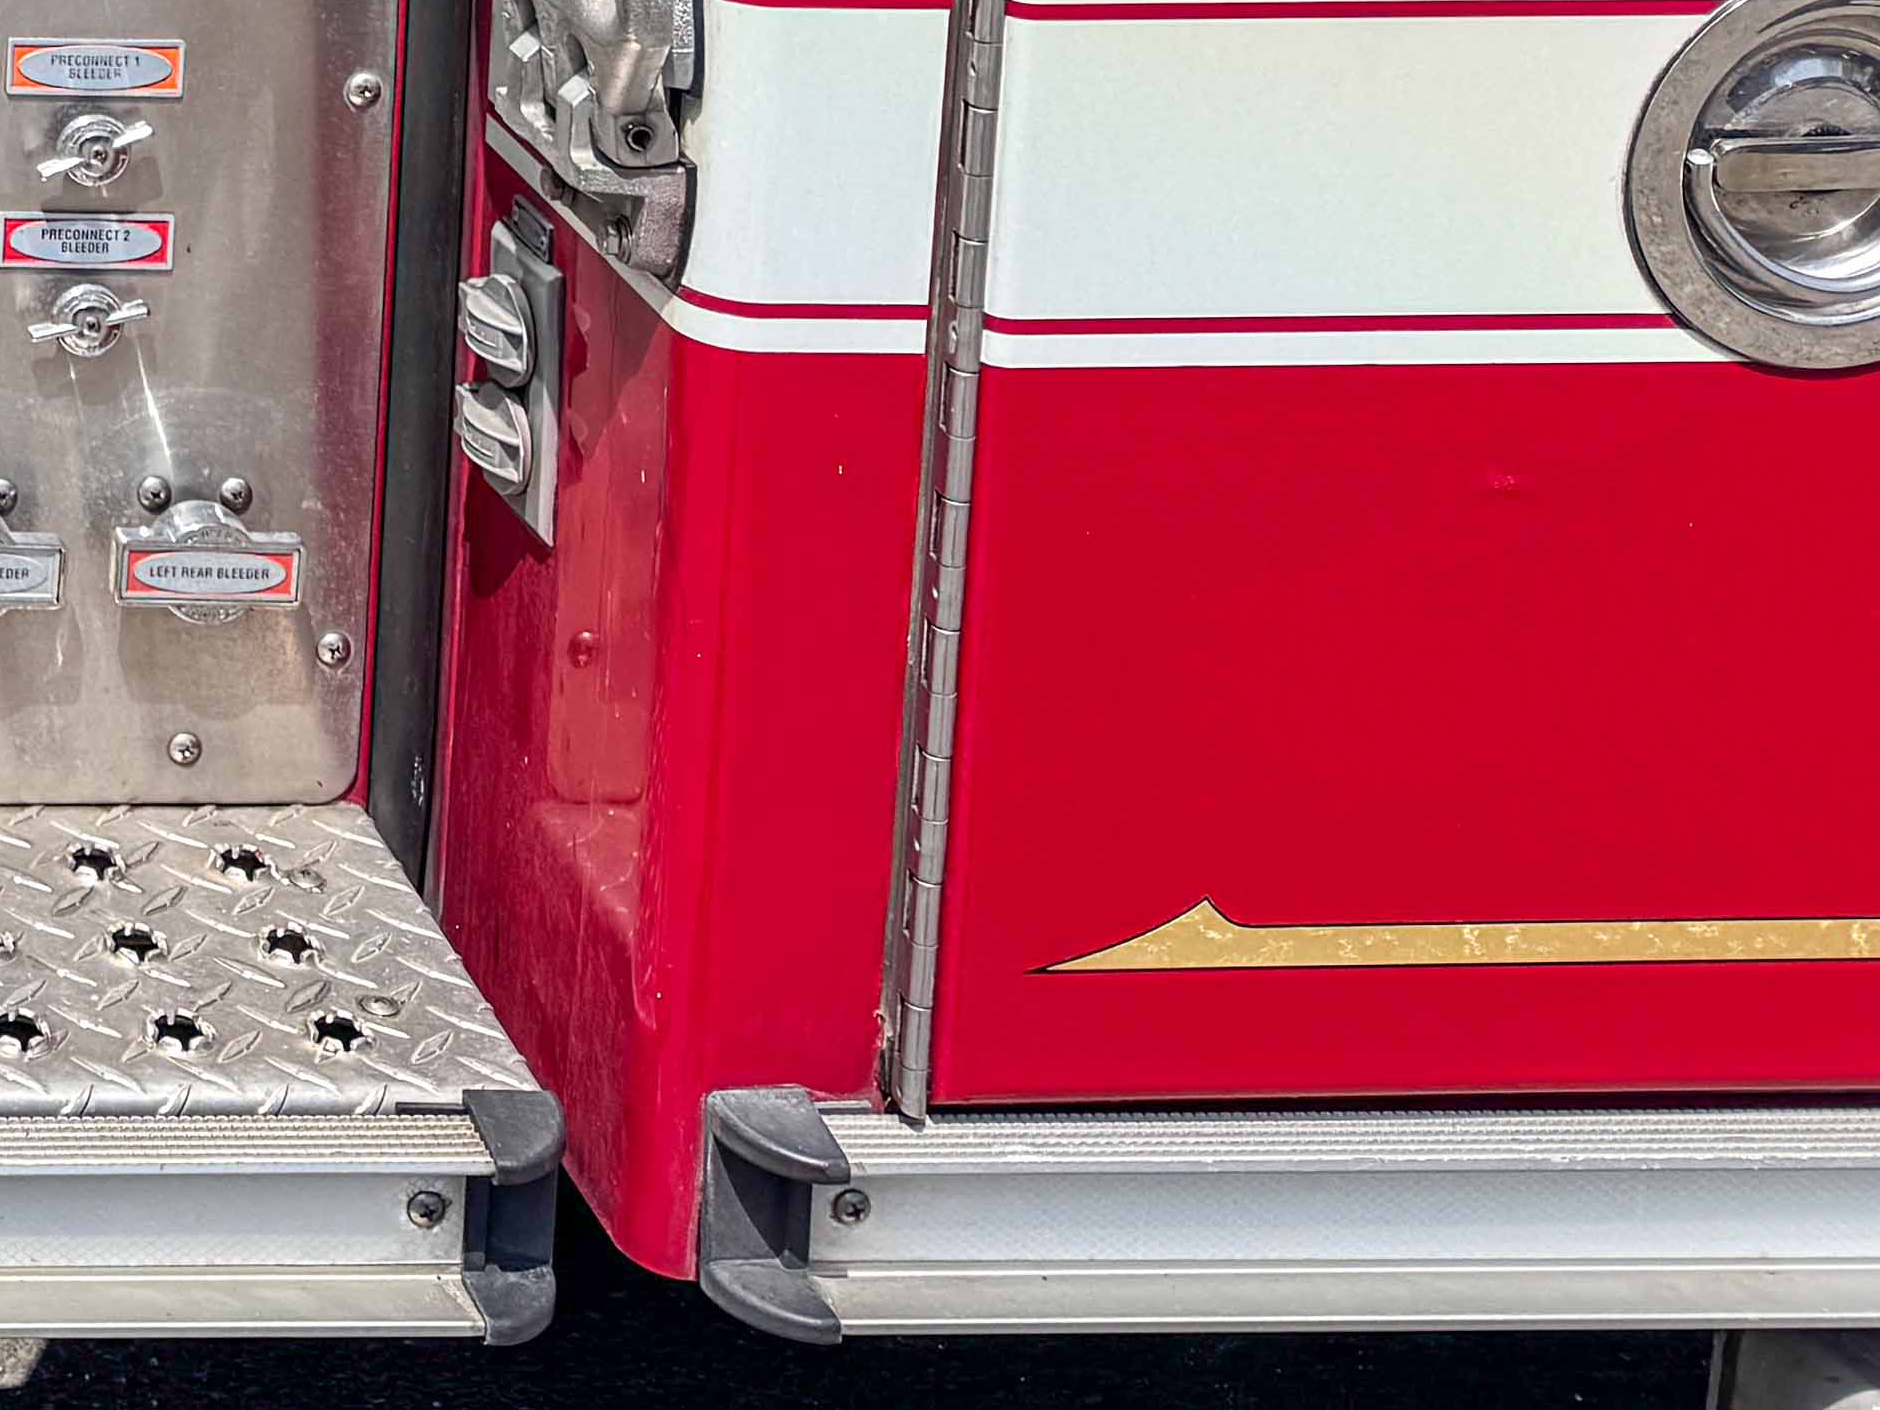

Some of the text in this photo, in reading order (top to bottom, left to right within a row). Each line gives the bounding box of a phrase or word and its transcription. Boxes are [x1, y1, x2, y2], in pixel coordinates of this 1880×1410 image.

[50, 54, 140, 67] PRECONNECT 1
[41, 228, 131, 242] PRECONNECT 2
[61, 241, 109, 254] BLEEDER
[150, 566, 270, 579] LEFT REAR BLEEDER
